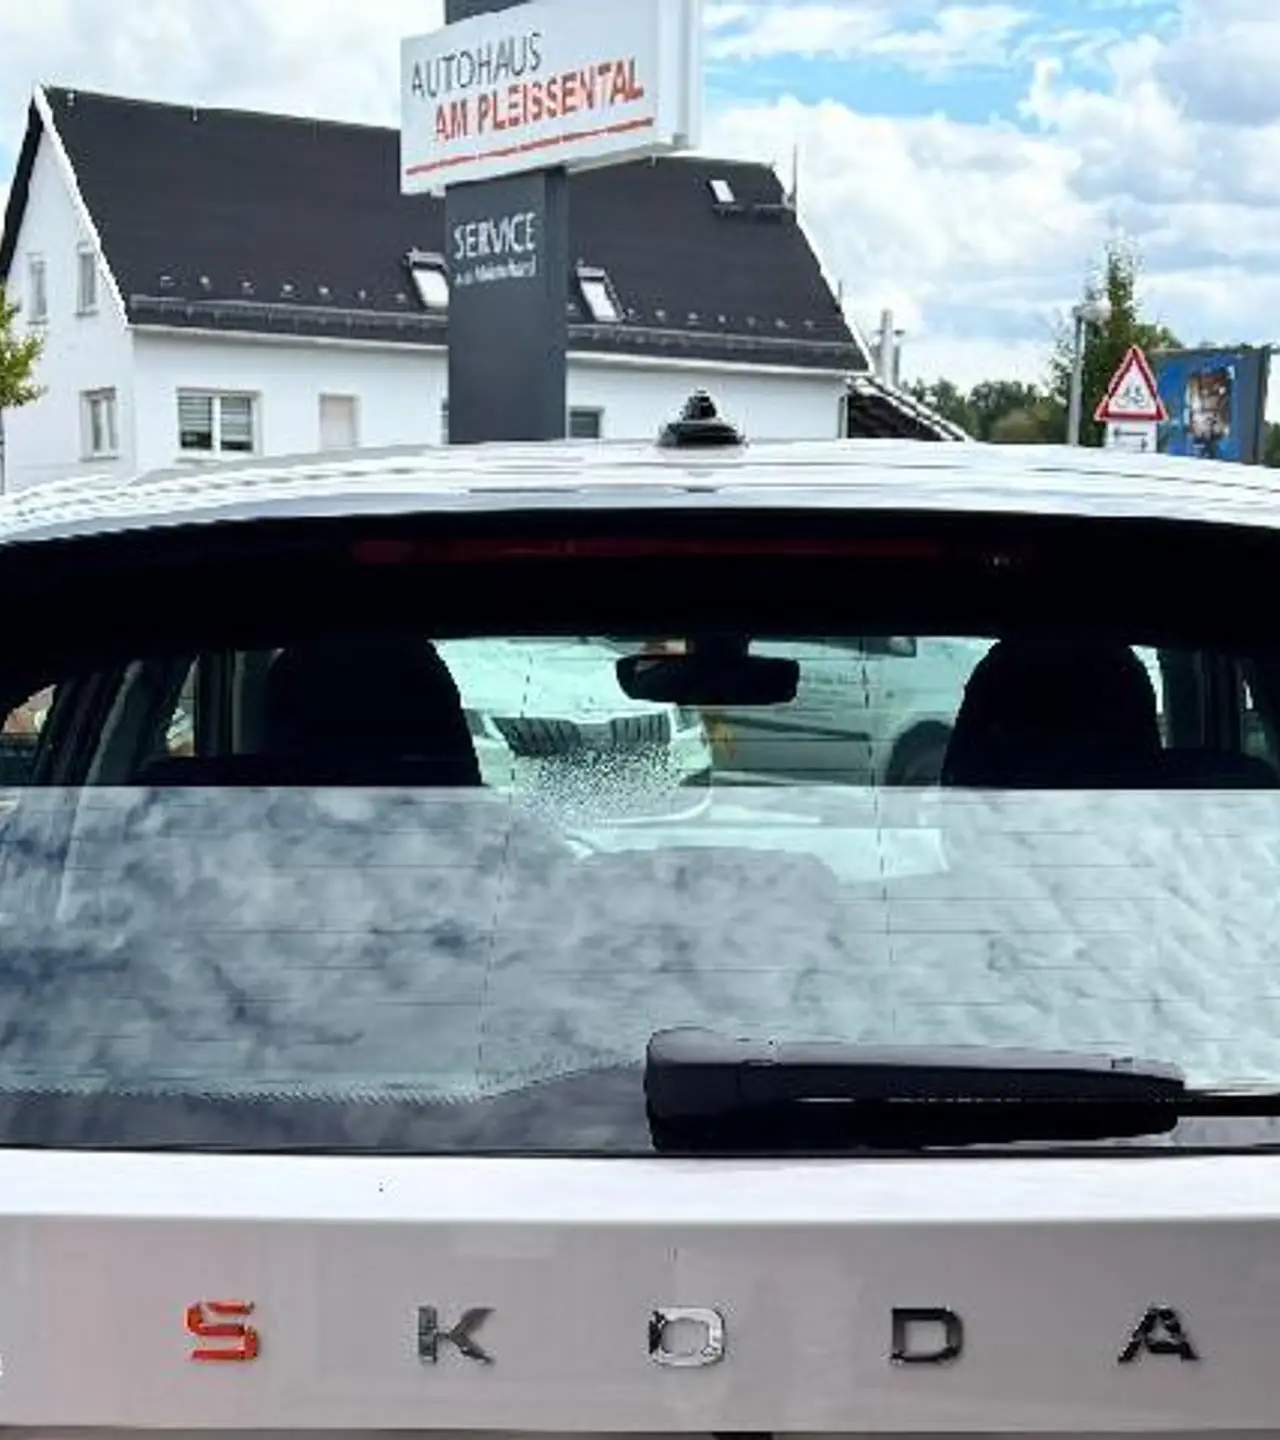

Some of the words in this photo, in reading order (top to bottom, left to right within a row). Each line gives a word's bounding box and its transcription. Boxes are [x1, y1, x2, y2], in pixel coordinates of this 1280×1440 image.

[411, 32, 542, 99] AUTOHAUS
[435, 99, 468, 142] AM
[477, 58, 645, 135] PLEISSENTAL
[453, 212, 537, 260] SERVICE
